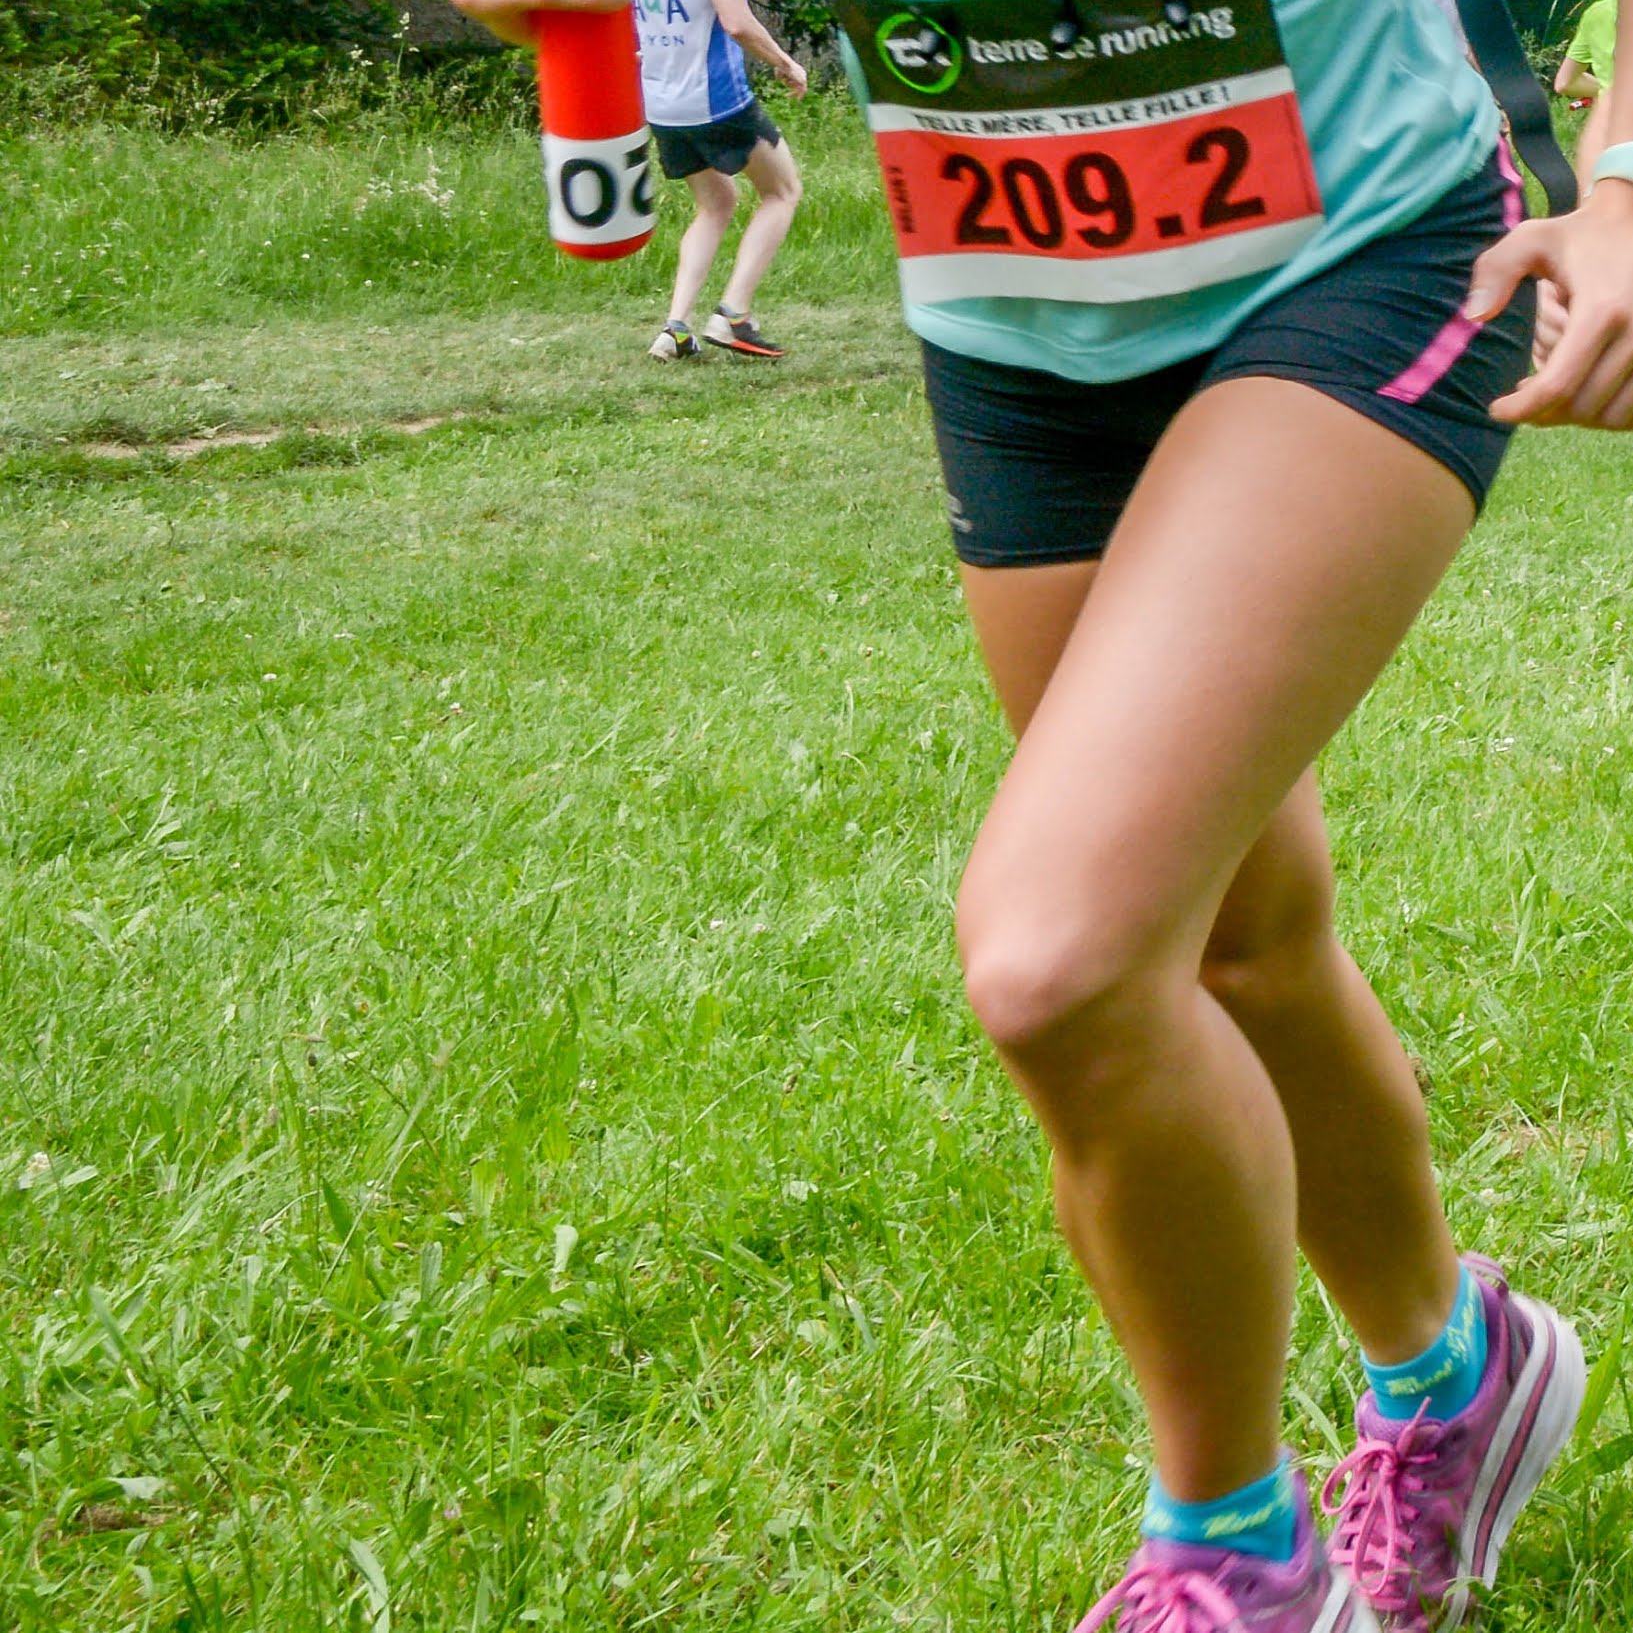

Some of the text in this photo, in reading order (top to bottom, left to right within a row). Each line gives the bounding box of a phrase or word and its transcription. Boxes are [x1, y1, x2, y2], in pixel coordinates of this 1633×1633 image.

[966, 34, 1048, 64] terre
[913, 113, 981, 134] TELLE
[1060, 106, 1142, 130] TELLE
[1144, 91, 1215, 119] FILLE
[940, 126, 1266, 250] 209.2
